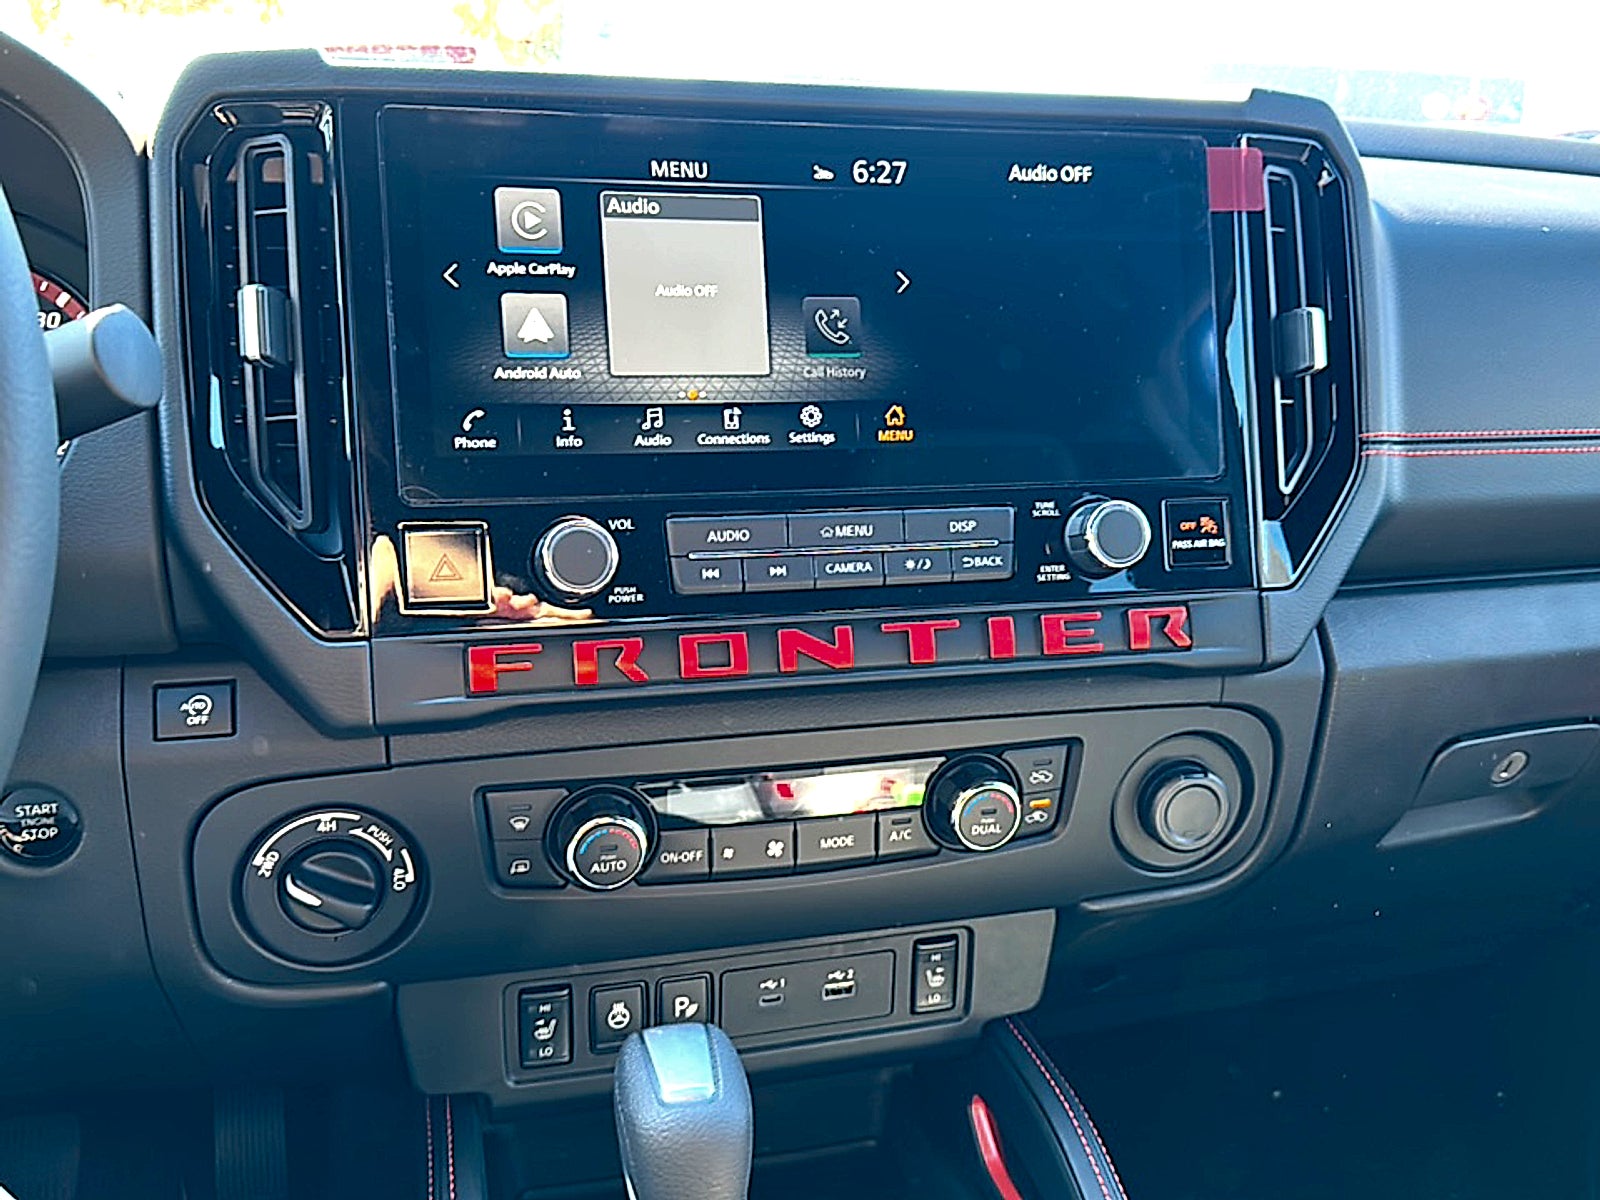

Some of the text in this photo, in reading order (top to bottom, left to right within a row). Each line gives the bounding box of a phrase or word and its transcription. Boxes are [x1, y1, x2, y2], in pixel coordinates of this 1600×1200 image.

[651, 160, 709, 179] MENU
[852, 159, 907, 185] 6:27
[1008, 164, 1093, 183] Audio OFF
[606, 197, 660, 215] Audio
[486, 262, 576, 279] Apple CarPlay
[654, 284, 719, 297] Audio OFF
[494, 366, 582, 380] Android Auto
[803, 366, 867, 381] Call History
[454, 435, 497, 449] Phone
[555, 434, 583, 448] Info
[634, 433, 672, 447] Audio
[697, 432, 771, 446] Connections
[788, 431, 836, 446] Settings
[877, 429, 914, 442] MENU
[608, 519, 636, 531] VOL
[834, 525, 874, 538] MENU
[949, 520, 977, 533] DISP
[1180, 521, 1197, 531] OFF
[707, 529, 750, 543] AUDIO
[825, 561, 873, 575] CAMERA
[974, 556, 1003, 568] BACK
[608, 593, 644, 604] POWER
[468, 606, 1193, 693] FRONTIER
[186, 715, 209, 726] OFF
[14, 802, 59, 818] START
[317, 820, 337, 832] 4H
[971, 823, 1002, 835] DUAL
[21, 826, 59, 841] STOP
[367, 824, 393, 846] PUSH
[889, 828, 912, 842] A/C
[820, 835, 855, 849] MODE
[660, 849, 704, 864] ON-OFF
[590, 860, 627, 874] AUTO
